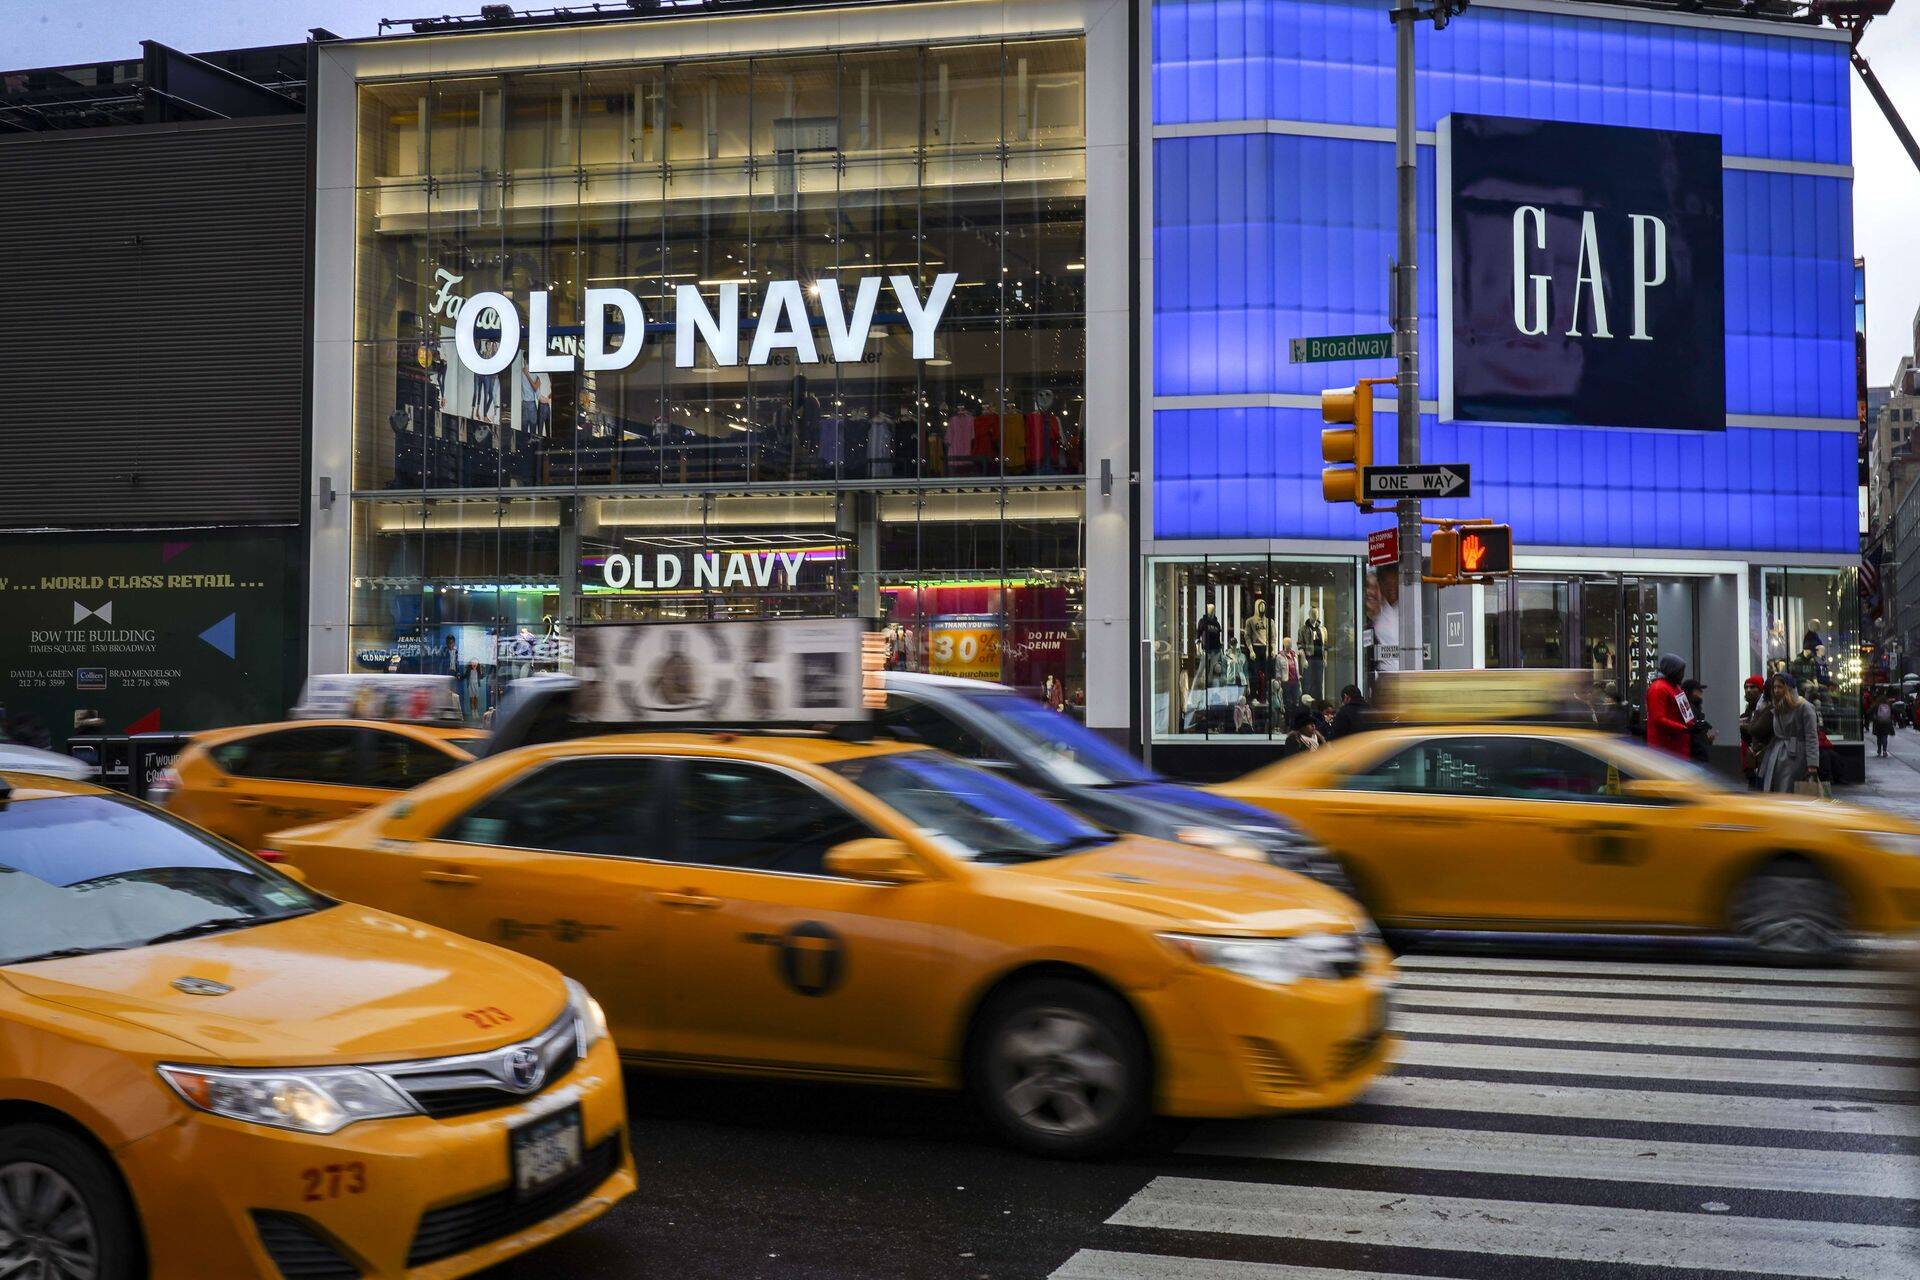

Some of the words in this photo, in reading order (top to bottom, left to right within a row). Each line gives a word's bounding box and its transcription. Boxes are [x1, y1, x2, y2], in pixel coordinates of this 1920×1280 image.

[1513, 206, 1667, 341] GAP
[455, 288, 646, 376] OLD
[675, 273, 959, 370] NAVY
[1312, 337, 1388, 358] Broadway
[1378, 475, 1409, 489] ONE
[1422, 475, 1454, 488] WAY
[604, 554, 683, 589] OLD
[694, 551, 808, 587] NAVY
[41, 577, 103, 590] WORLD
[108, 575, 164, 589] CLASS
[168, 574, 234, 588] RETAIL
[31, 630, 62, 642] BOW
[65, 630, 85, 642] TIE
[89, 629, 155, 642] BUILDING
[29, 645, 52, 653] TIMES
[53, 645, 86, 654] SQUARE
[109, 644, 156, 652] BROADWAY
[934, 636, 978, 663] 30
[1028, 642, 1060, 650] DENIM
[980, 654, 996, 663] off
[10, 670, 36, 678] DAVID
[47, 670, 73, 678] GREEN
[109, 669, 128, 678] BRAD
[130, 669, 182, 678] MENDELSON
[960, 670, 999, 679] purchase
[19, 679, 31, 687] 212
[34, 679, 46, 687] 716
[49, 679, 65, 687] 3599
[122, 679, 135, 687] 212
[138, 679, 150, 687] 716
[463, 1005, 514, 1030] 273
[301, 1161, 368, 1202] 273
